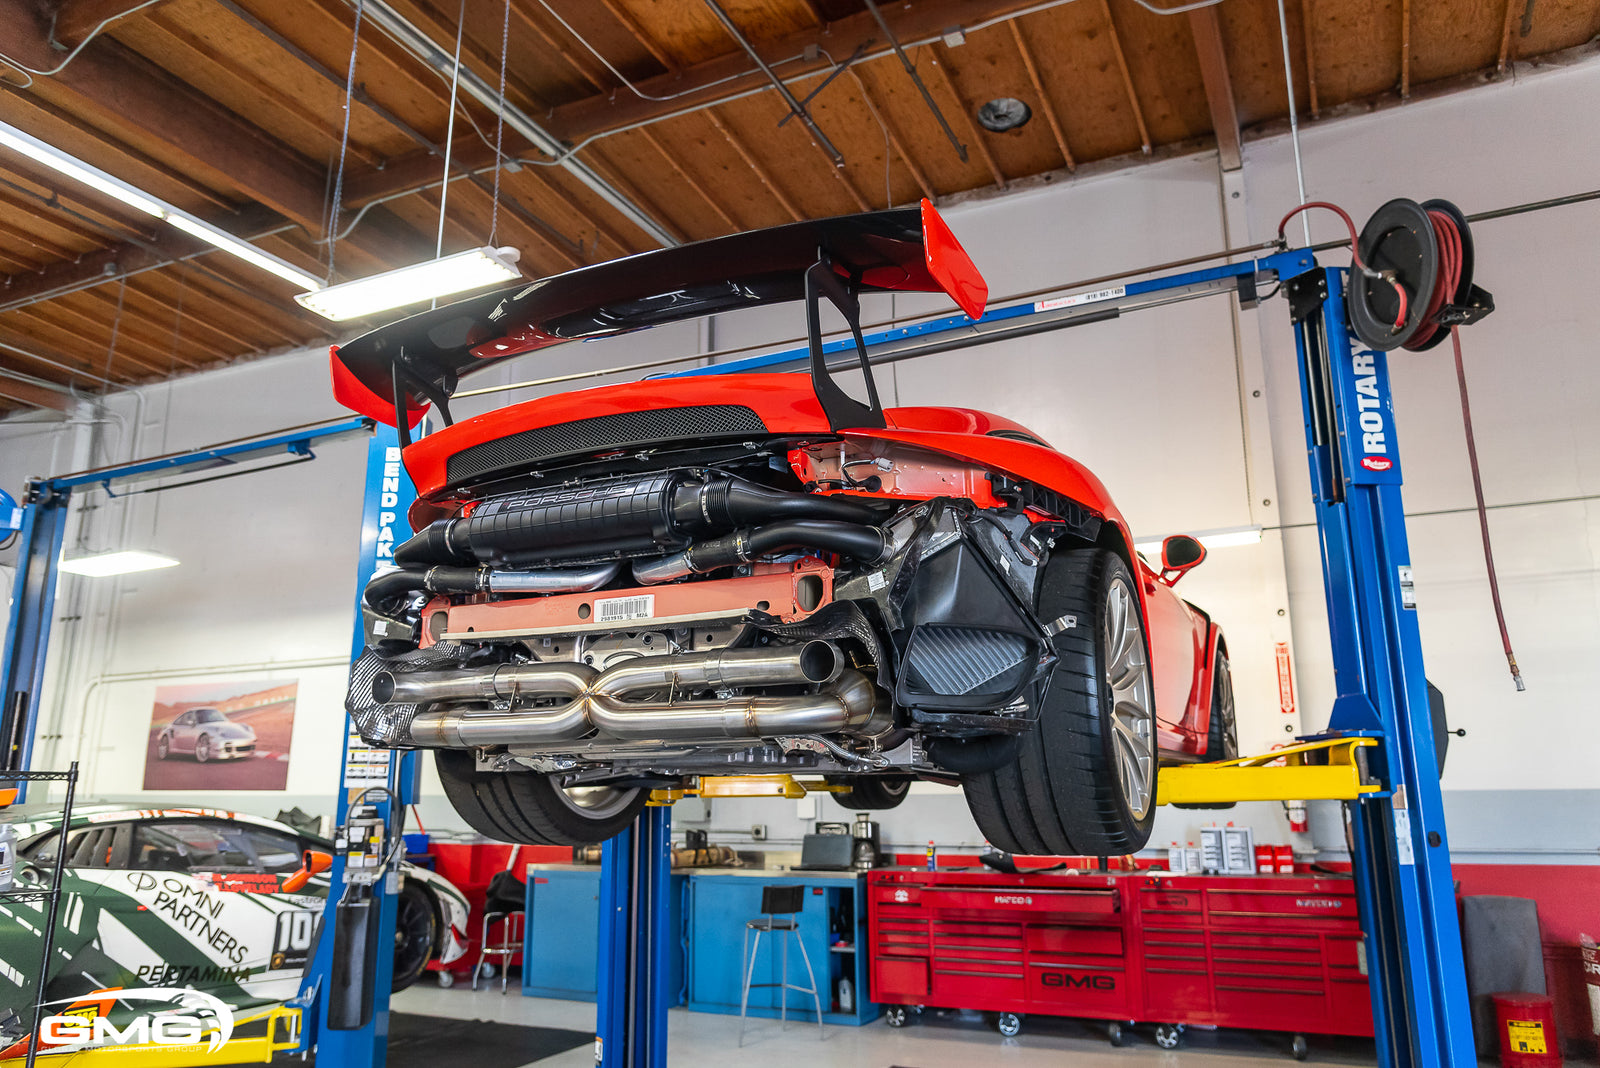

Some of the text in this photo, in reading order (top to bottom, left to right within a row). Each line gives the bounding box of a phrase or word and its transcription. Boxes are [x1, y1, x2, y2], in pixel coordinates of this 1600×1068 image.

[1350, 337, 1387, 454] ROTARY
[506, 484, 628, 510] PORSCHE
[163, 878, 225, 919] OMNI
[153, 891, 249, 964] PARTNERS
[134, 964, 251, 982] PERTAMINA
[1041, 972, 1116, 990] GMG
